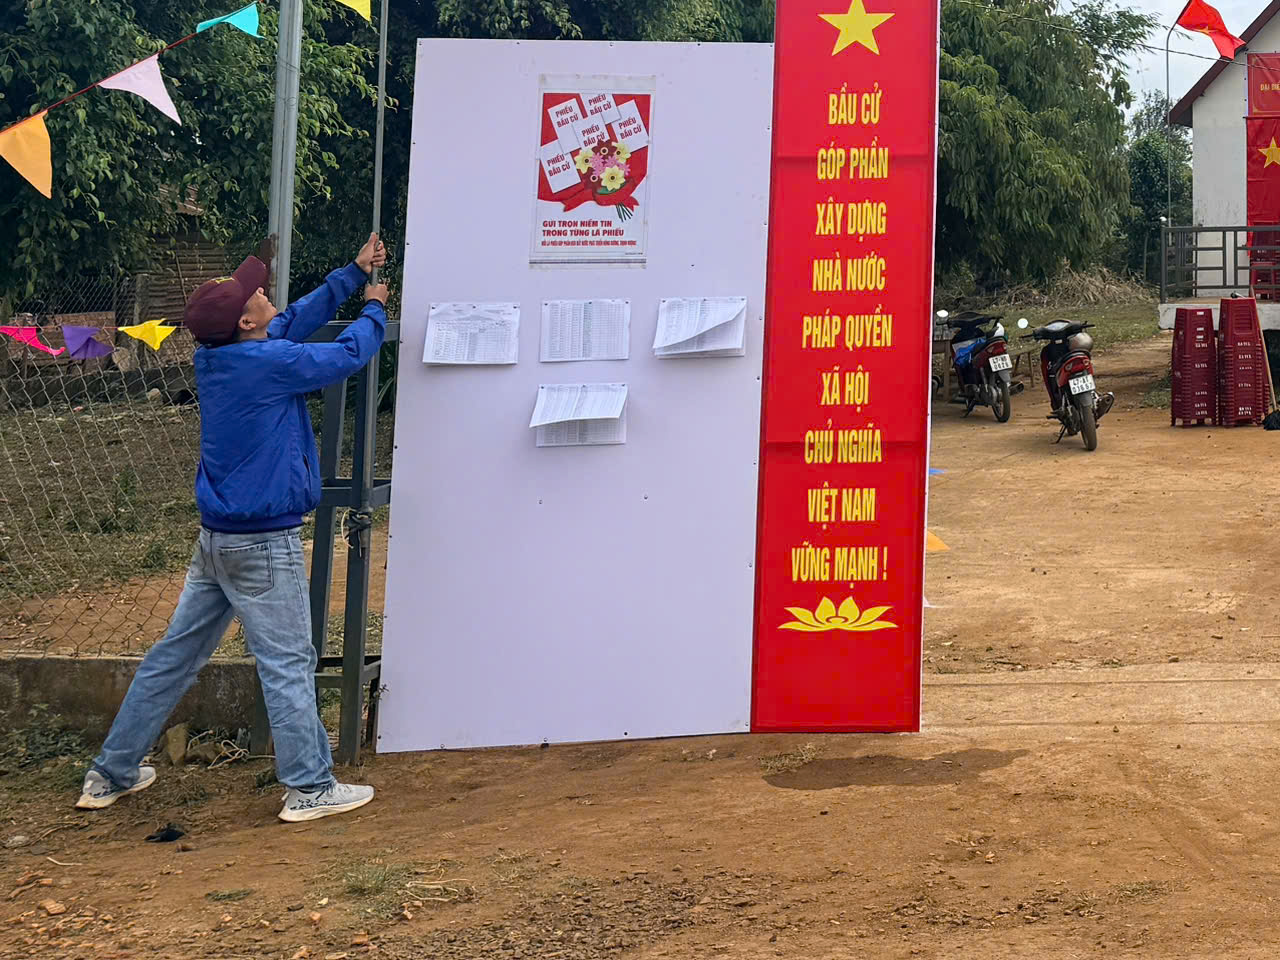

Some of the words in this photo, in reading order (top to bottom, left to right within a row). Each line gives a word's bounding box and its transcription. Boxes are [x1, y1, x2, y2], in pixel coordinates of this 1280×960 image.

[829, 85, 856, 124] BẦU
[862, 82, 882, 124] CỬ
[818, 142, 845, 179] GÓP
[850, 138, 888, 179] PHẦN
[600, 220, 612, 228] TIN
[816, 198, 845, 236] XÂY
[848, 200, 886, 240] DỰNG
[813, 253, 842, 291] NHÀ
[847, 253, 885, 290] NƯỚC
[802, 309, 841, 348] PHÁP
[845, 304, 892, 350] QUYỀN
[821, 367, 840, 405] XÃ
[845, 365, 869, 412] HỘI
[805, 420, 833, 464] CHỦ
[838, 424, 881, 463] NGHĨA
[808, 482, 838, 528] VIỆT
[842, 488, 875, 520] NAM
[792, 542, 830, 581] VỮNG
[834, 547, 878, 588] MẠNH
